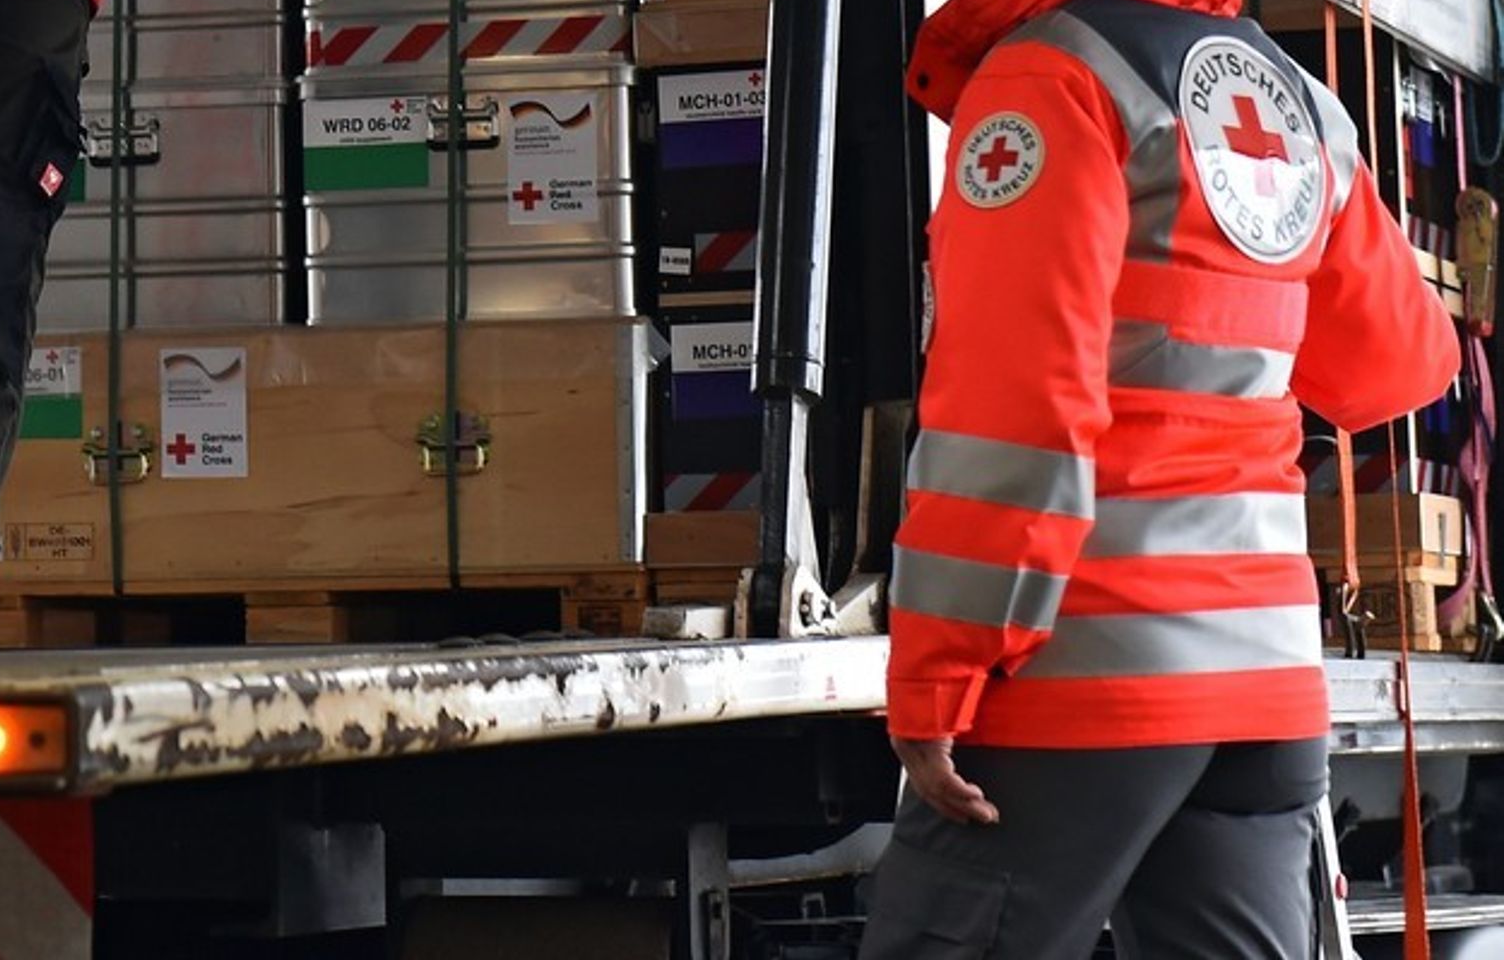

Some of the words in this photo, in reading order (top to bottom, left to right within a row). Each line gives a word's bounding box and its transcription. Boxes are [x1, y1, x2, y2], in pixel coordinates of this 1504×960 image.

[1190, 52, 1301, 133] DEUTSCHES
[322, 117, 364, 133] WRD
[367, 115, 412, 132] 06-02
[968, 120, 1036, 154] DEUTSCHES
[548, 179, 593, 188] German
[964, 164, 988, 199] ROTES
[991, 161, 1033, 198] KREUZ
[550, 200, 584, 211] Cross
[201, 433, 244, 442] German
[201, 444, 223, 454] Red
[201, 455, 233, 465] Cross
